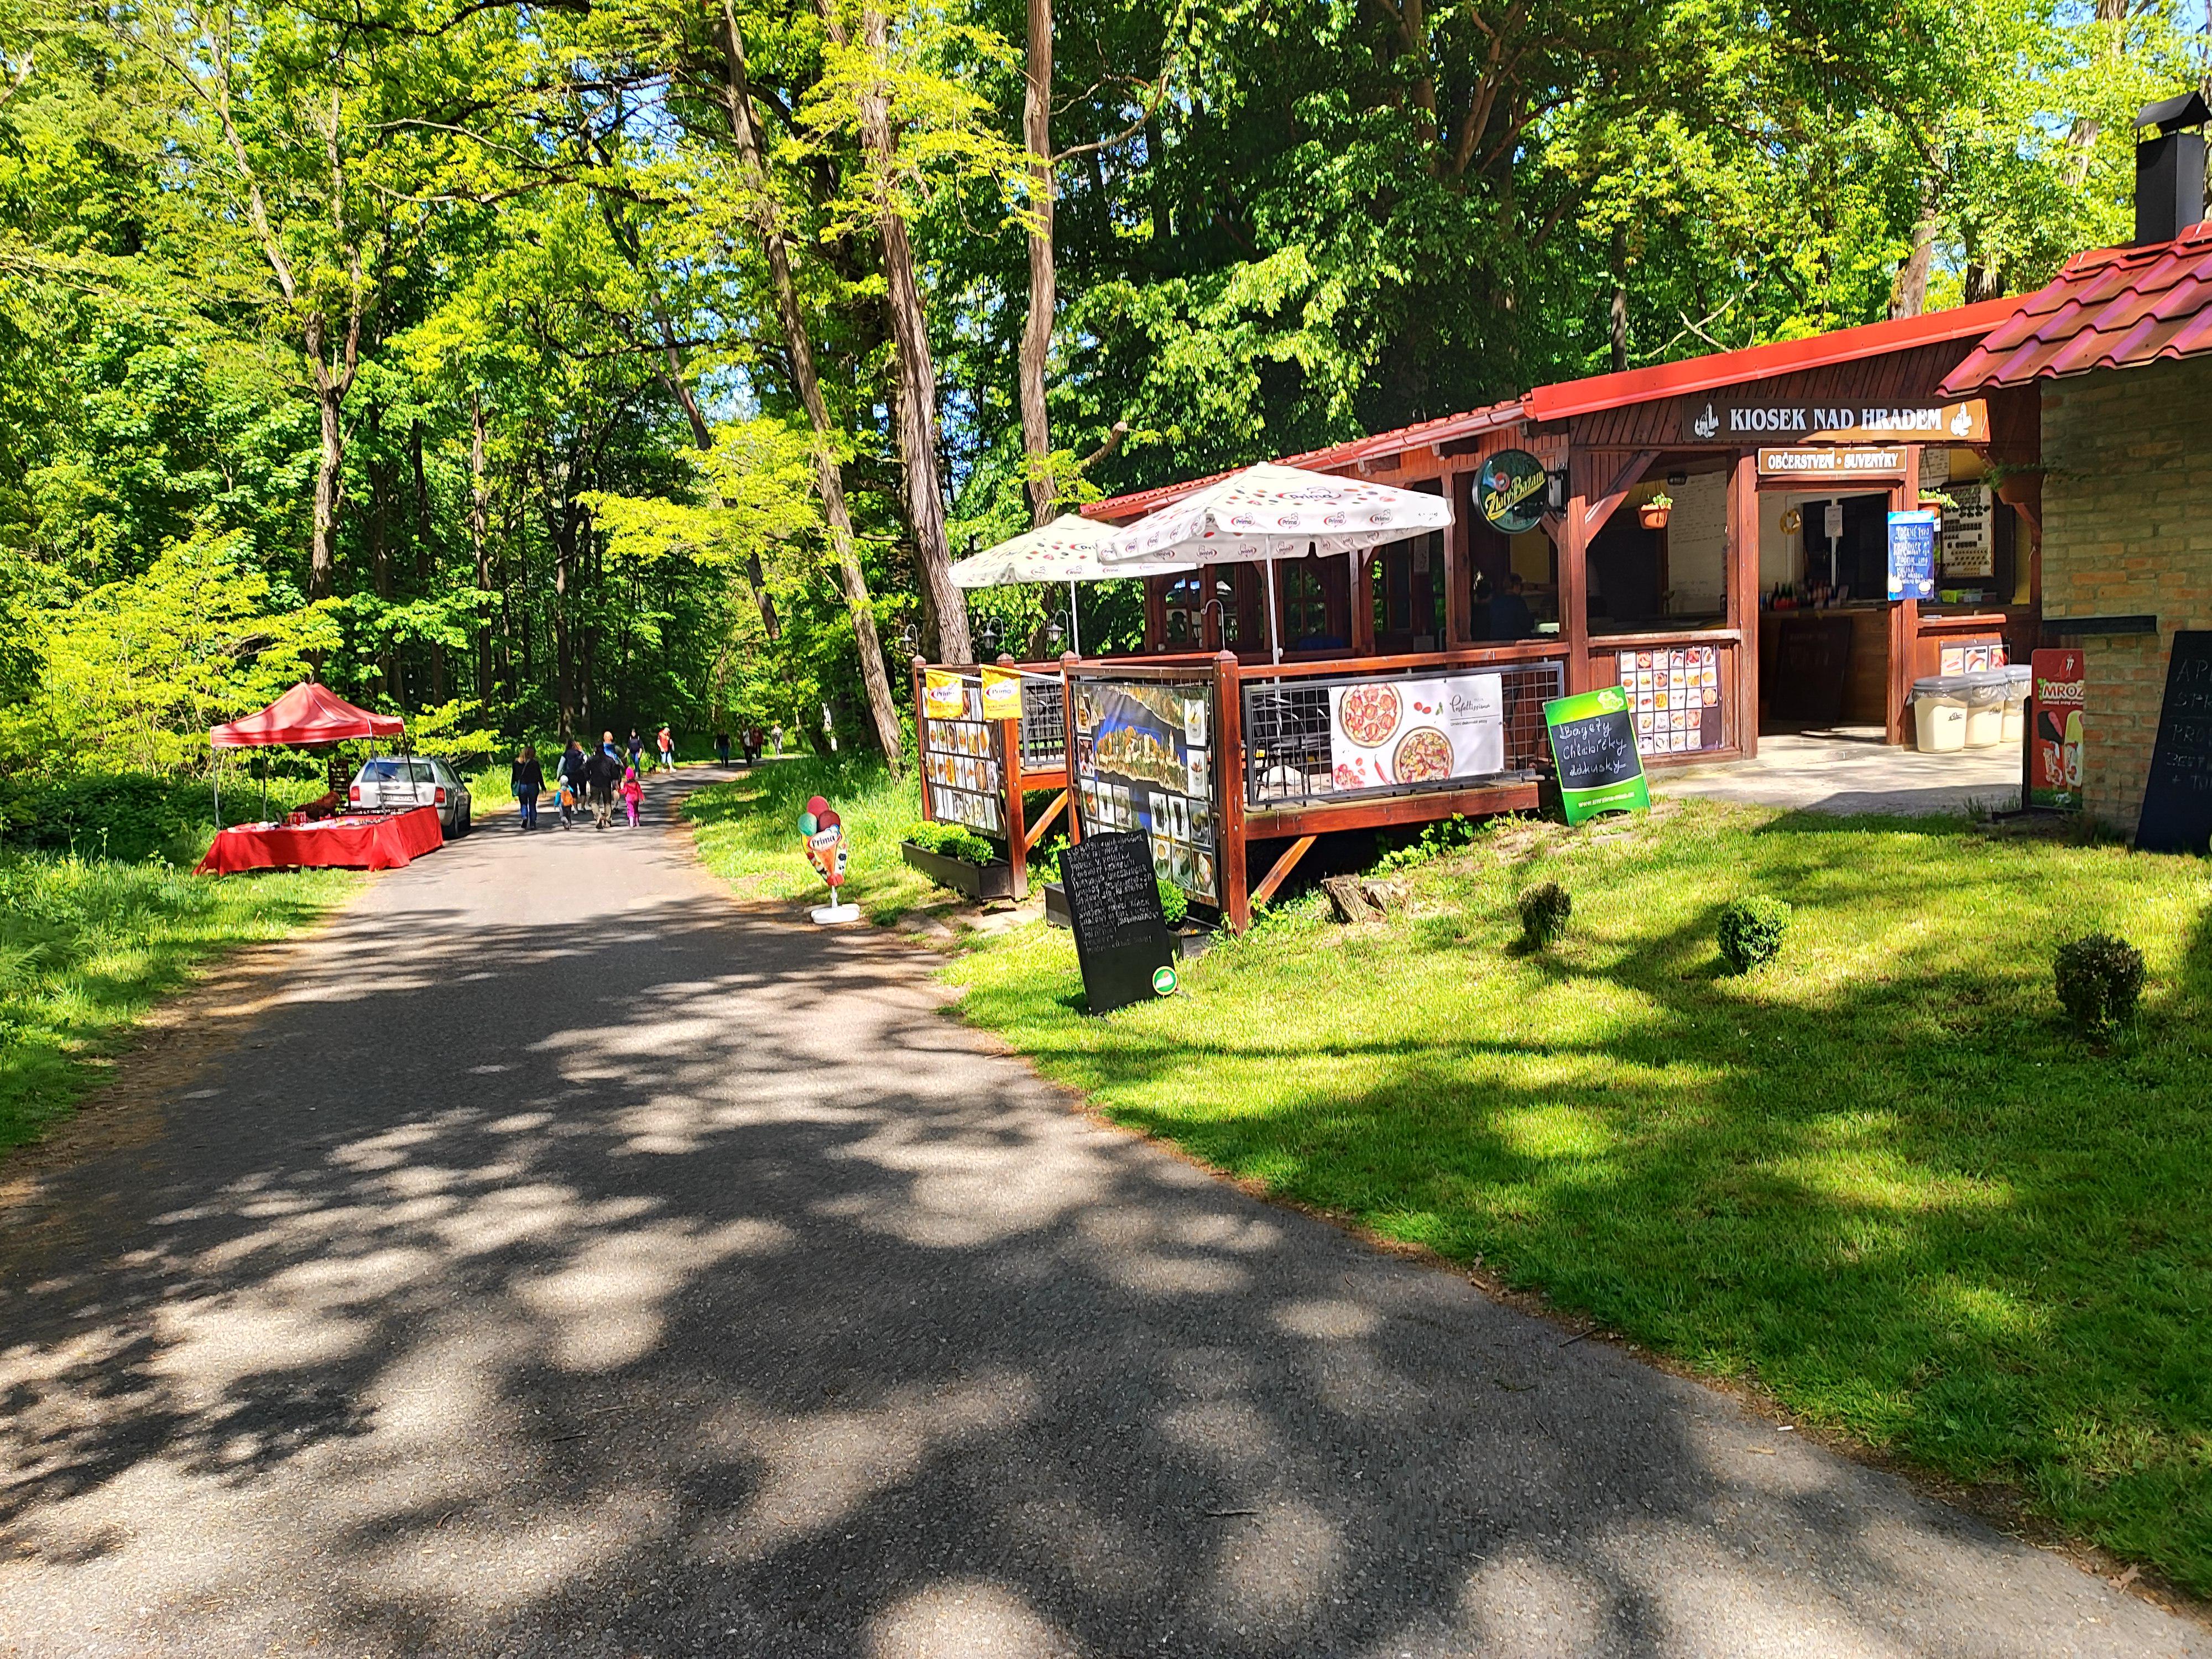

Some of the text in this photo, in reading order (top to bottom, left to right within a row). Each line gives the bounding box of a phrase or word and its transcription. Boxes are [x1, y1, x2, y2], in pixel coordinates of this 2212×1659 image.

[1730, 408, 1942, 430] KIOSEK NAD HRADEM
[812, 835, 836, 847] Prima
